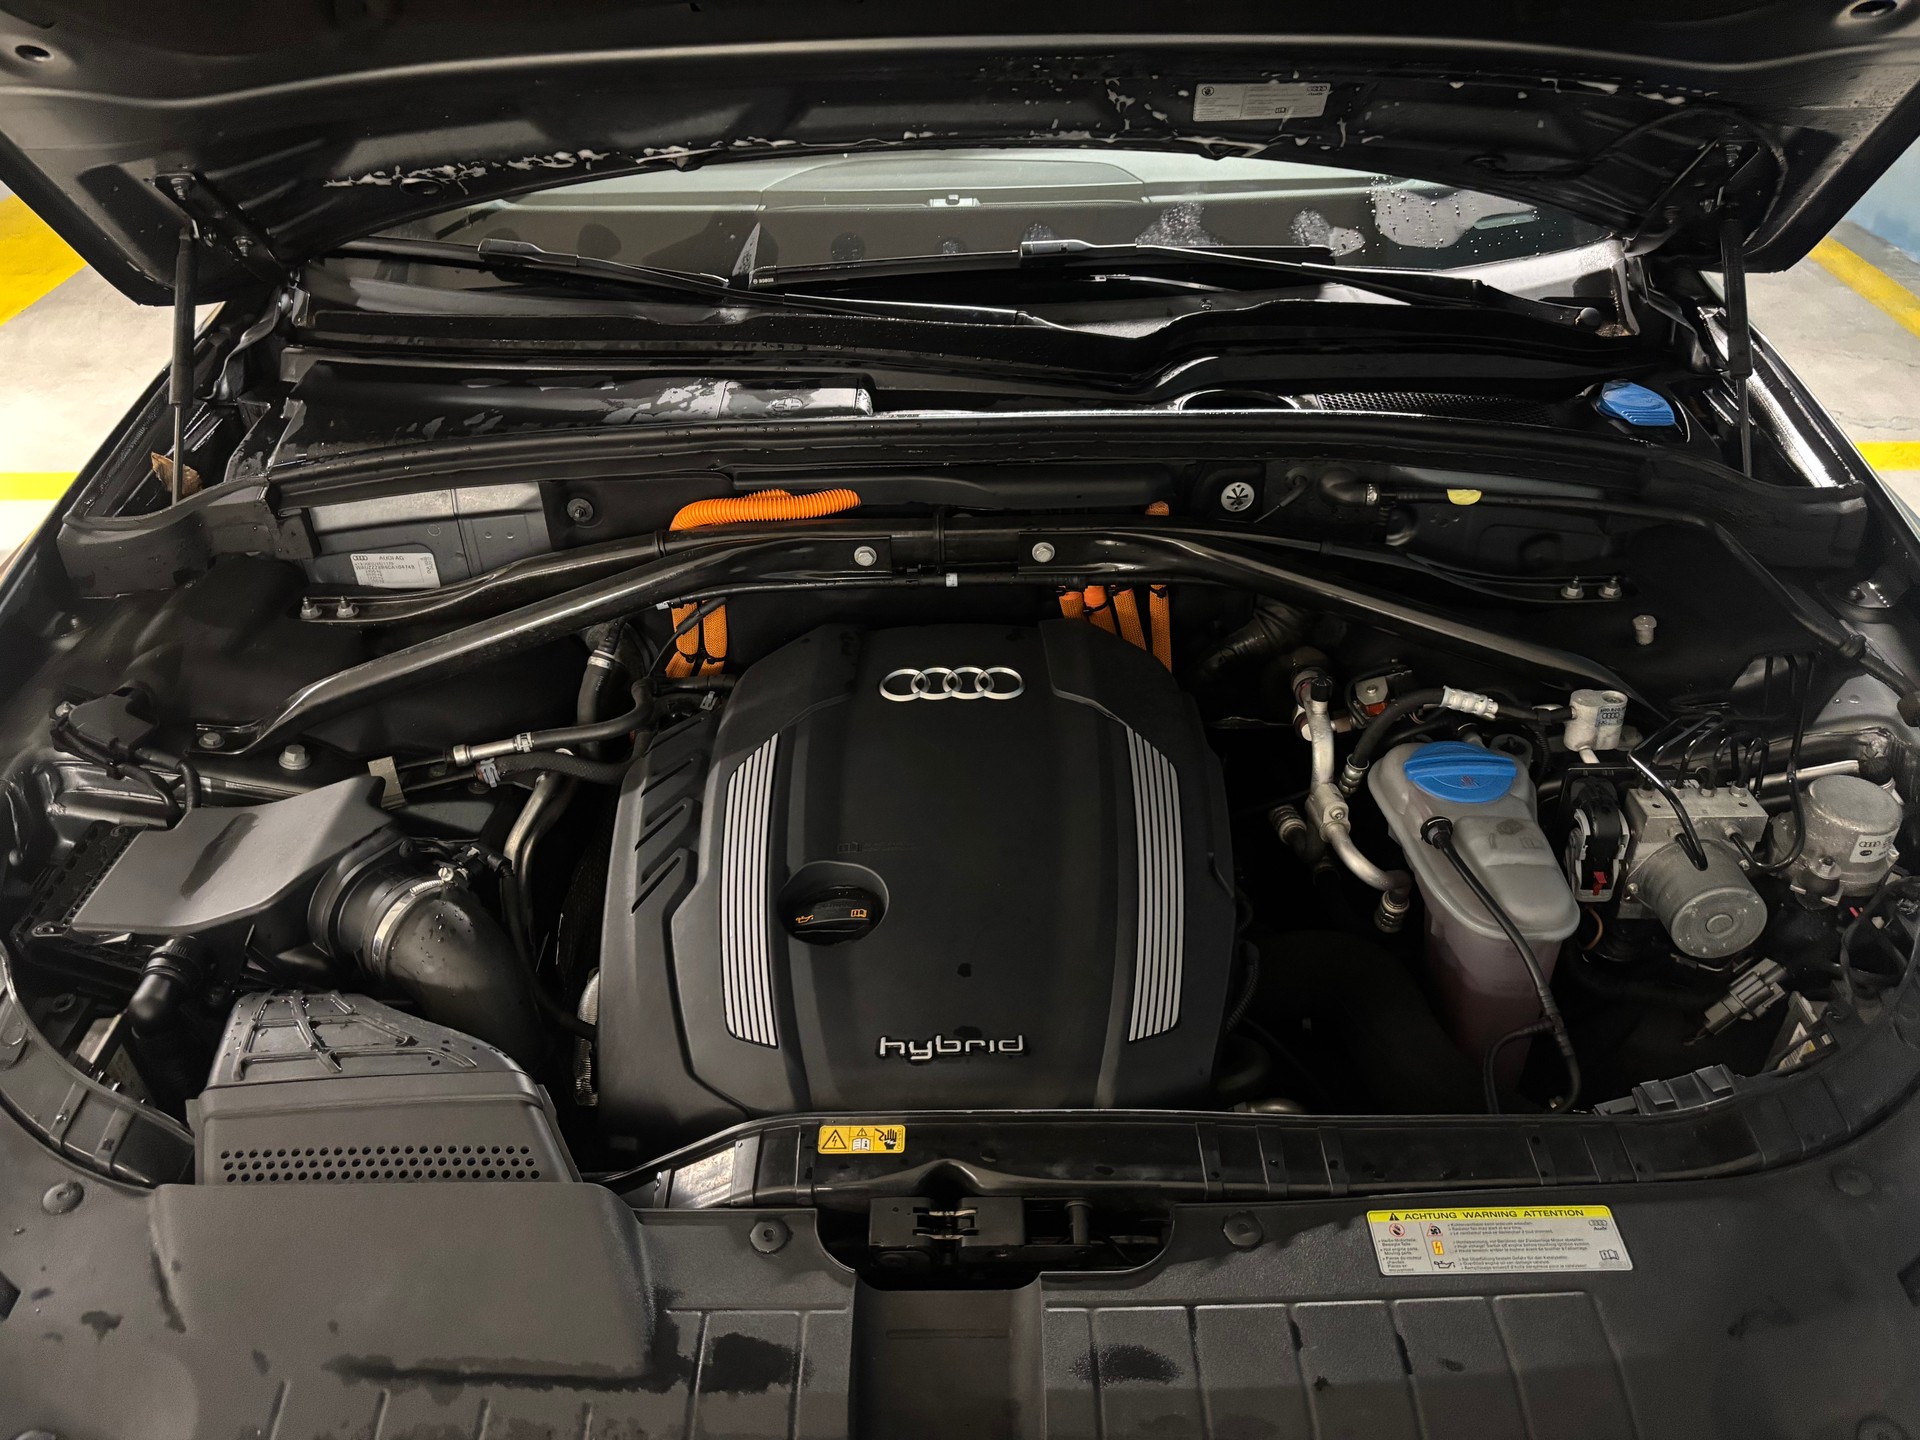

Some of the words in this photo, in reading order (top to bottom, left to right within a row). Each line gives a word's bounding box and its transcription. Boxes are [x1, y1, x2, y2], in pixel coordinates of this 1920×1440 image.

[879, 1034, 1024, 1060] hybrid
[1404, 1211, 1457, 1221] ACHTUNG
[1462, 1210, 1517, 1219] WARNING
[1523, 1209, 1584, 1217] ATTENTION
